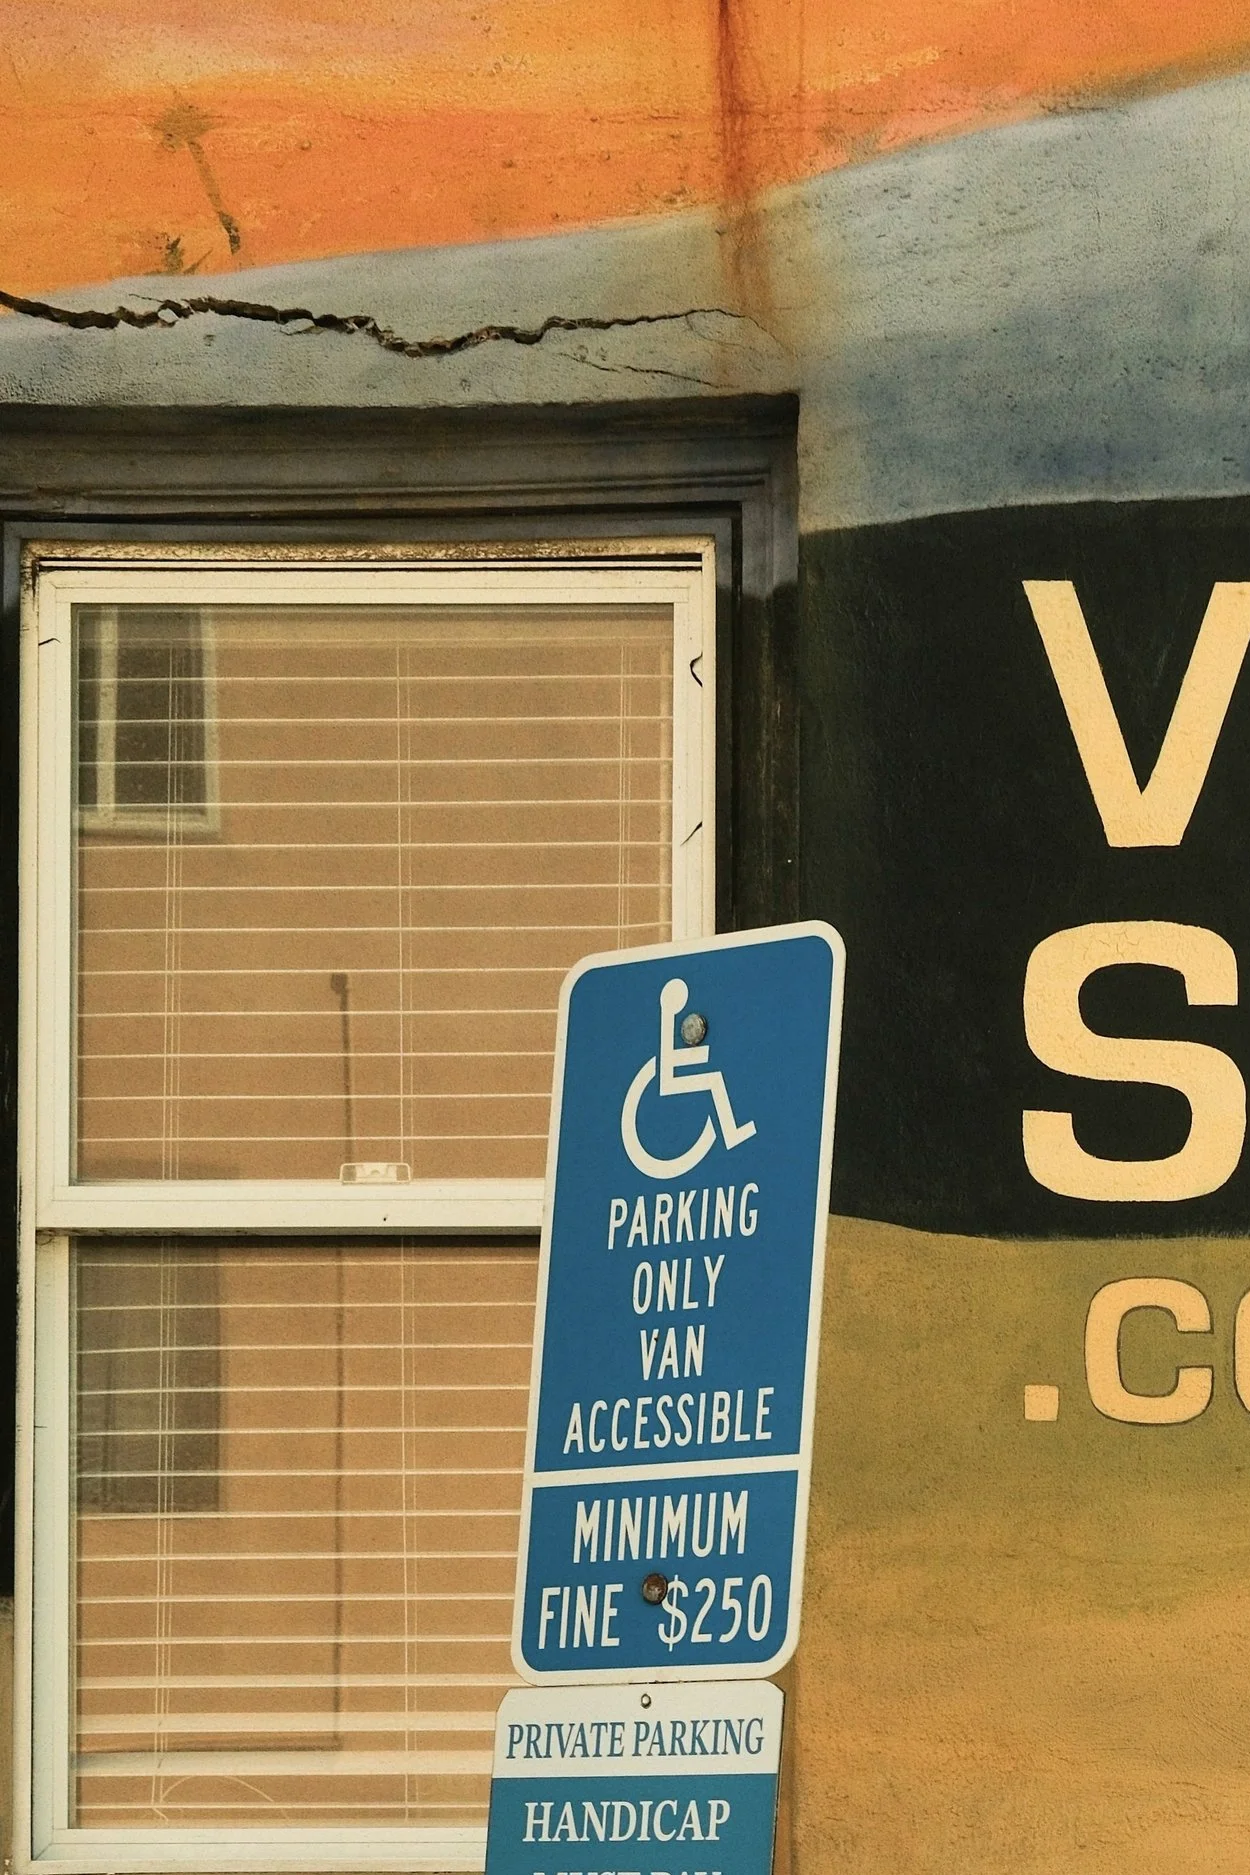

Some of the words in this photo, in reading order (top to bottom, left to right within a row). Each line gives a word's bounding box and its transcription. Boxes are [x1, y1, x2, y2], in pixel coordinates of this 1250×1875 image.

[607, 1182, 760, 1250] PARKING
[632, 1254, 725, 1315] ONLY
[639, 1324, 706, 1381] VAN
[562, 1387, 775, 1455] ACCESSIBLE
[572, 1490, 750, 1564] MINIMUM
[537, 1583, 624, 1650] FINE
[657, 1574, 774, 1652] $250
[505, 1721, 625, 1760] PRIVATE
[631, 1717, 765, 1758] PARKING
[522, 1799, 731, 1843] HANDICAP
